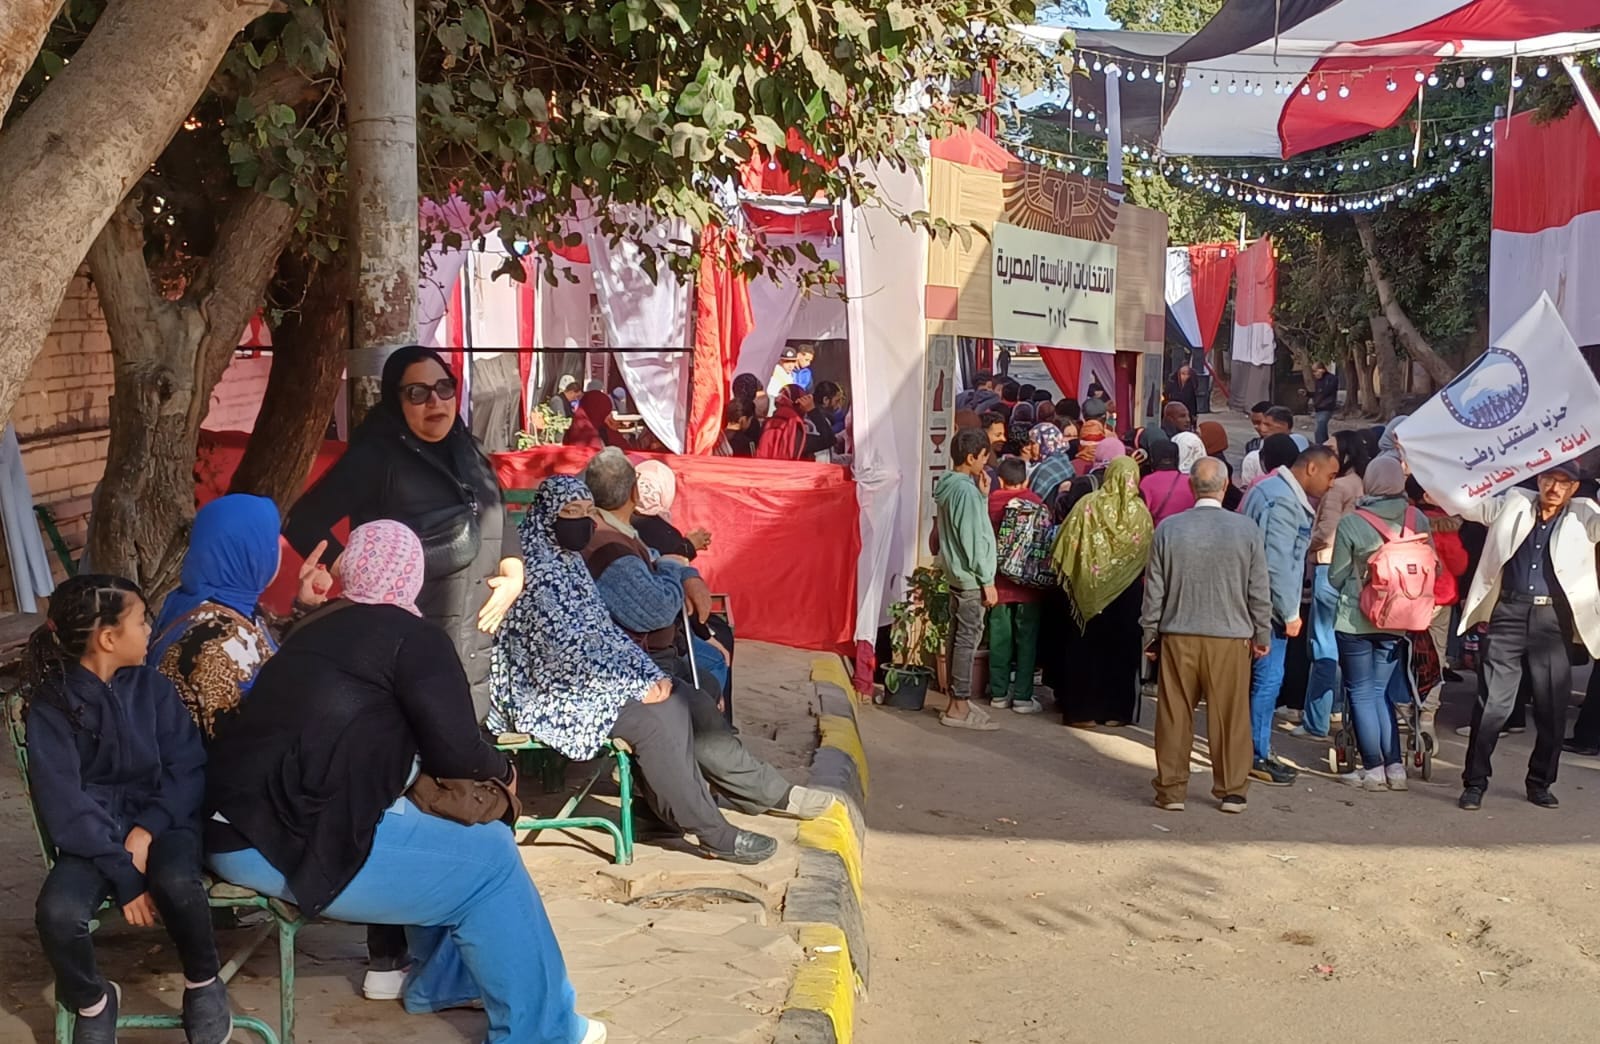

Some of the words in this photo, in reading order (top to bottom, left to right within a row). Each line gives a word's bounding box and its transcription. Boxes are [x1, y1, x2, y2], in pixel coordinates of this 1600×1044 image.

[996, 247, 1039, 285] المصرية
[1039, 255, 1073, 294] الرئاسية
[1073, 261, 1114, 298] الانتخابات
[1047, 305, 1067, 329] ٢٠٢٤
[1541, 406, 1567, 432] حزب
[1497, 422, 1539, 456] مستقبل
[1460, 446, 1496, 471] وطن
[1525, 447, 1552, 472] قسم
[1461, 465, 1520, 498] الطالبية
